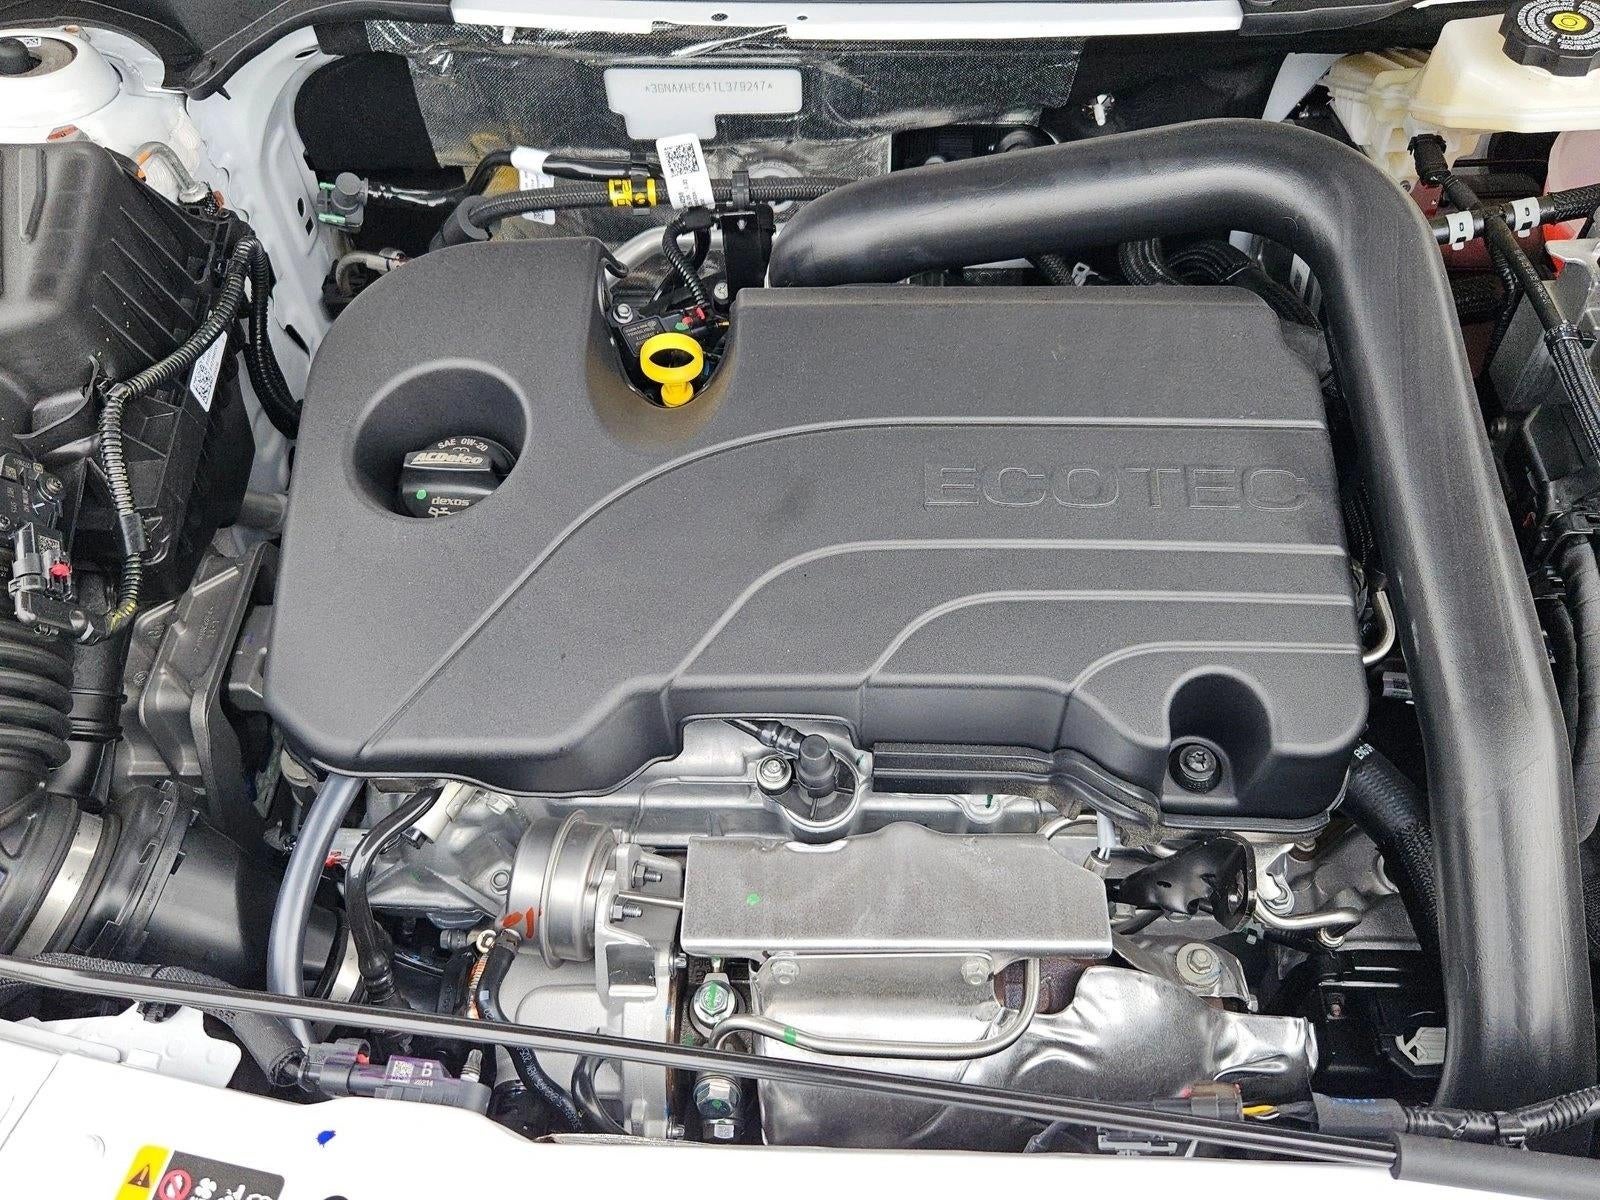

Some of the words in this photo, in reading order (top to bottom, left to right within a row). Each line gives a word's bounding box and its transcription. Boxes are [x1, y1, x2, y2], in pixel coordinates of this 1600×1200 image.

[437, 439, 457, 450] SAE
[410, 452, 484, 465] ACDelco
[924, 466, 1308, 512] ECOTEC
[431, 496, 471, 507] dexos
[421, 1061, 434, 1078] B
